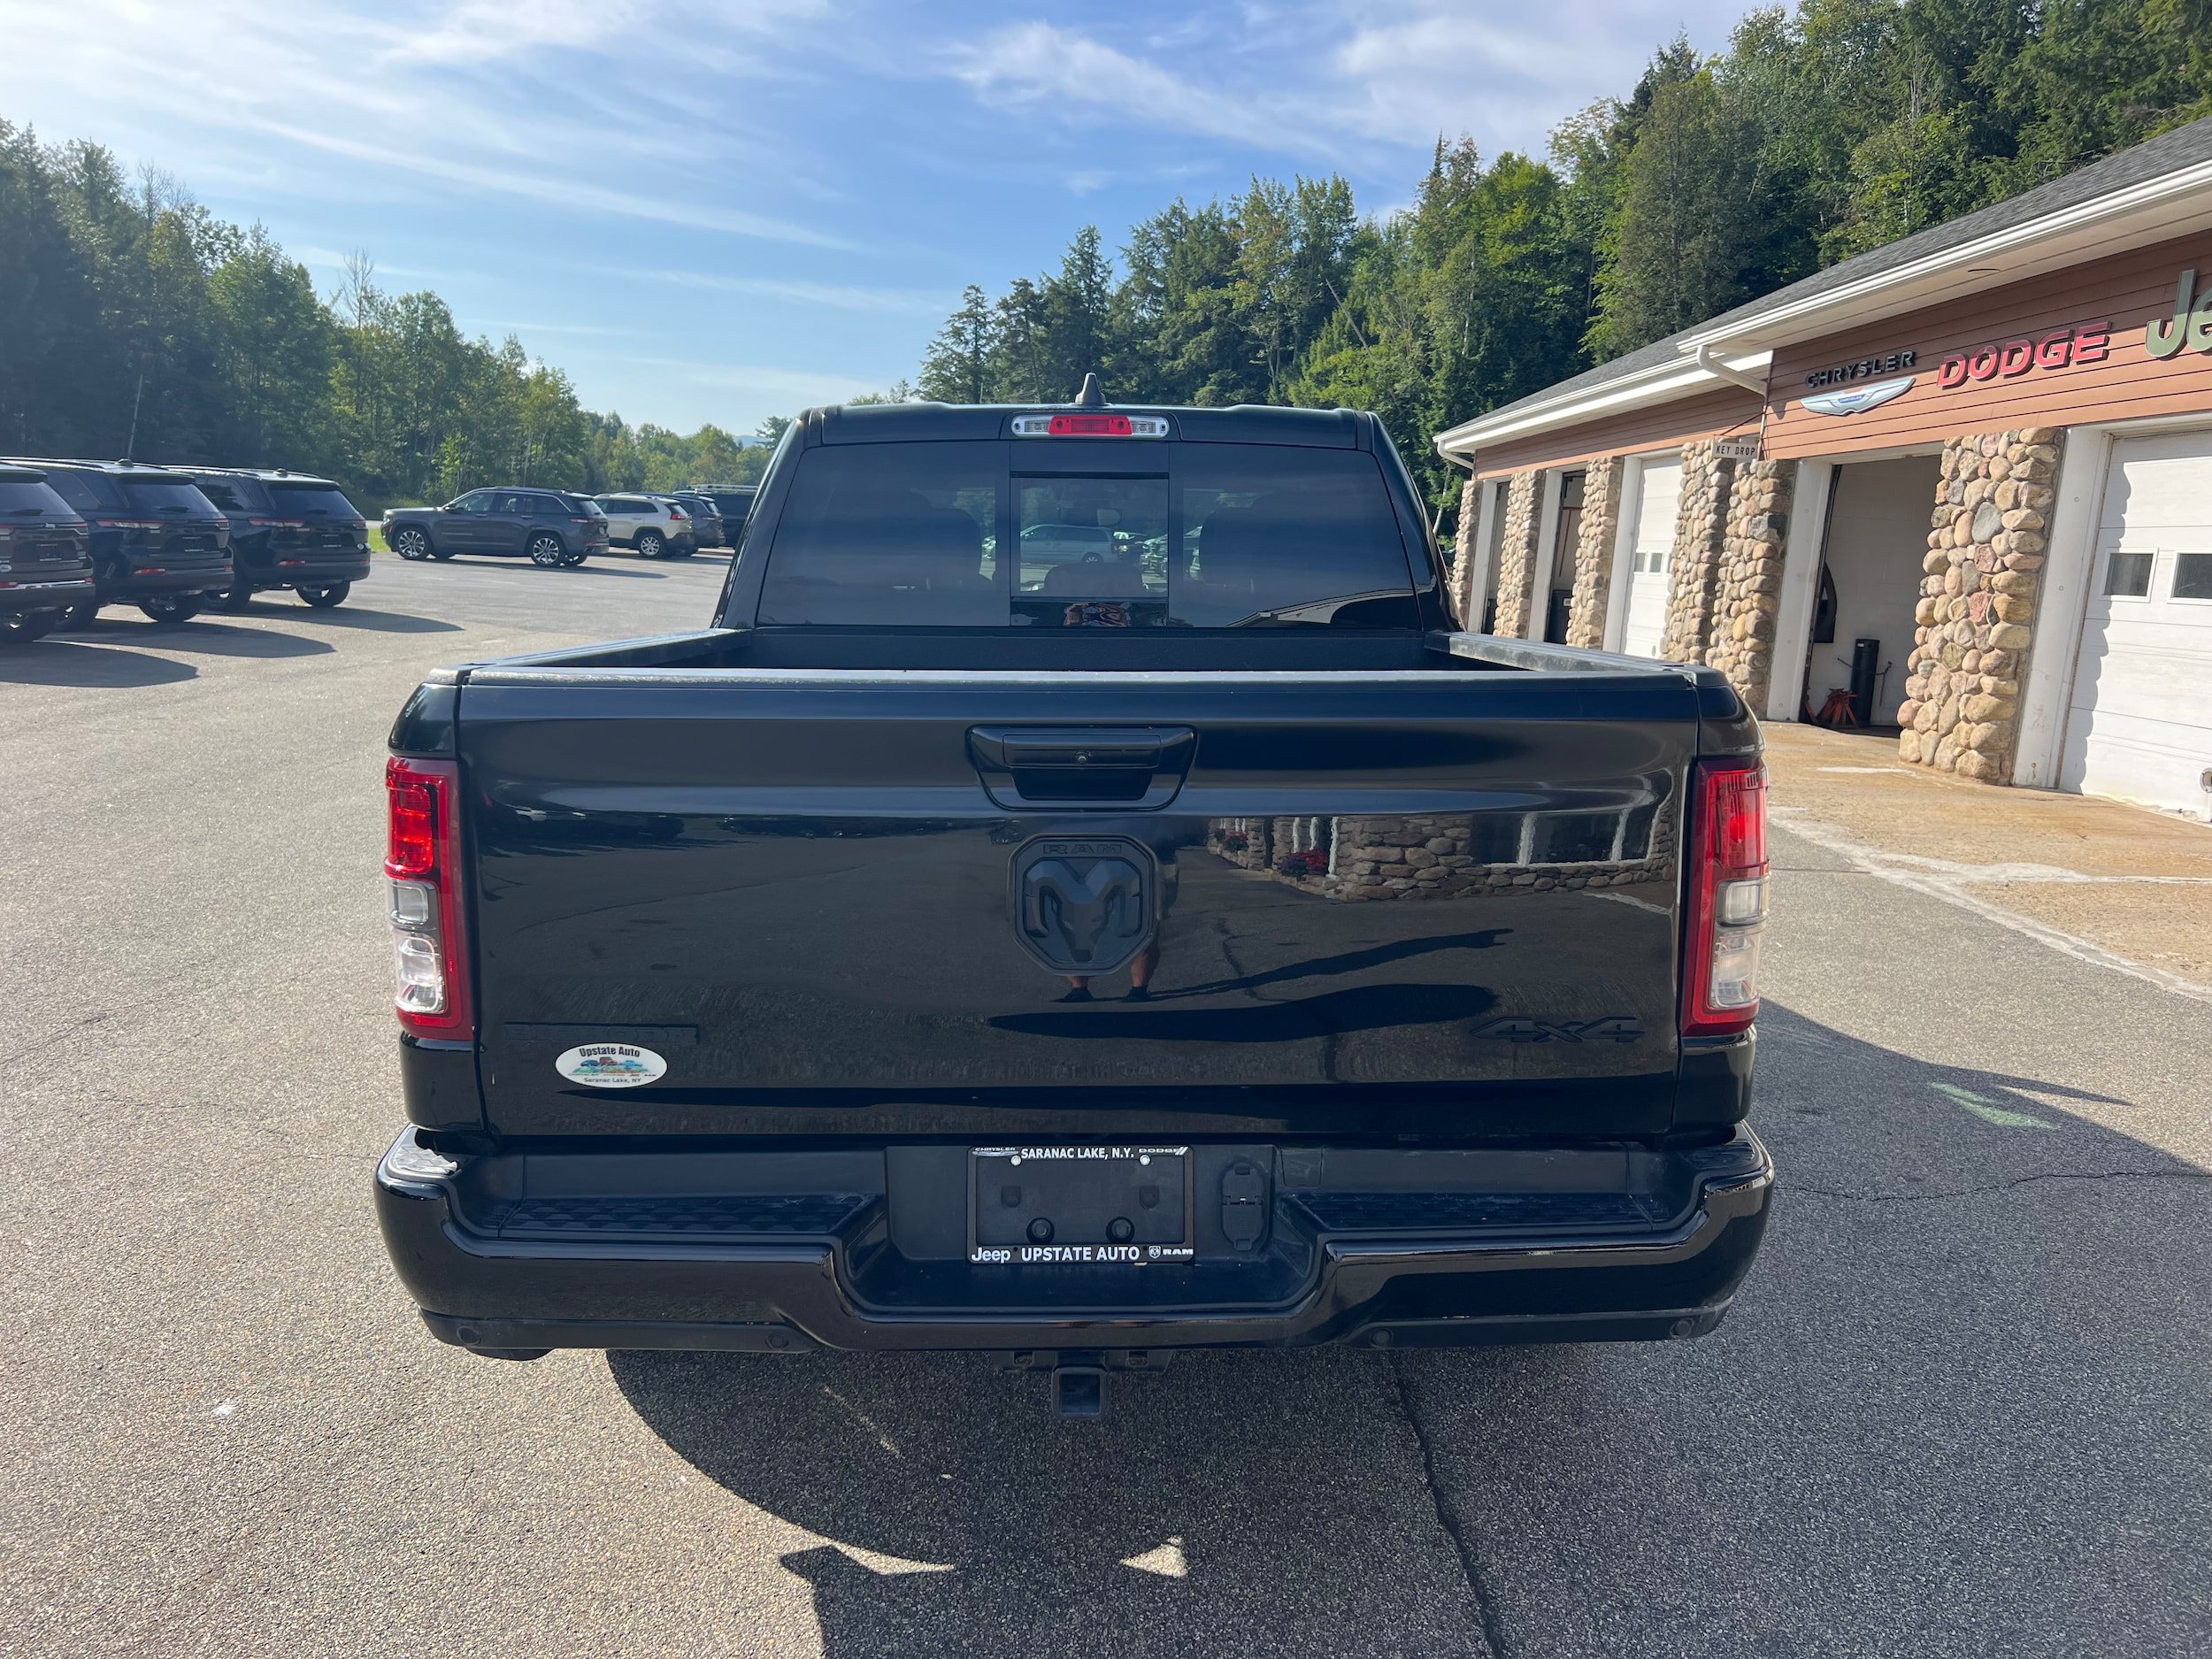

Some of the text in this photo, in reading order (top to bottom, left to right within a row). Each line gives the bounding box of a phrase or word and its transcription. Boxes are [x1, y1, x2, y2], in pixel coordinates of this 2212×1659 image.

[1936, 321, 2111, 390] DODGE
[1805, 350, 1916, 388] CHRYSLER
[1717, 445, 1755, 456] KEY DROP
[1042, 843, 1123, 855] RAM
[579, 1046, 641, 1057] Upstate Auto
[1021, 1148, 1134, 1160] SARANAC LAKE, N.Y.
[972, 1247, 1011, 1263] Jeep
[1021, 1246, 1141, 1262] UPSTATE AUTO
